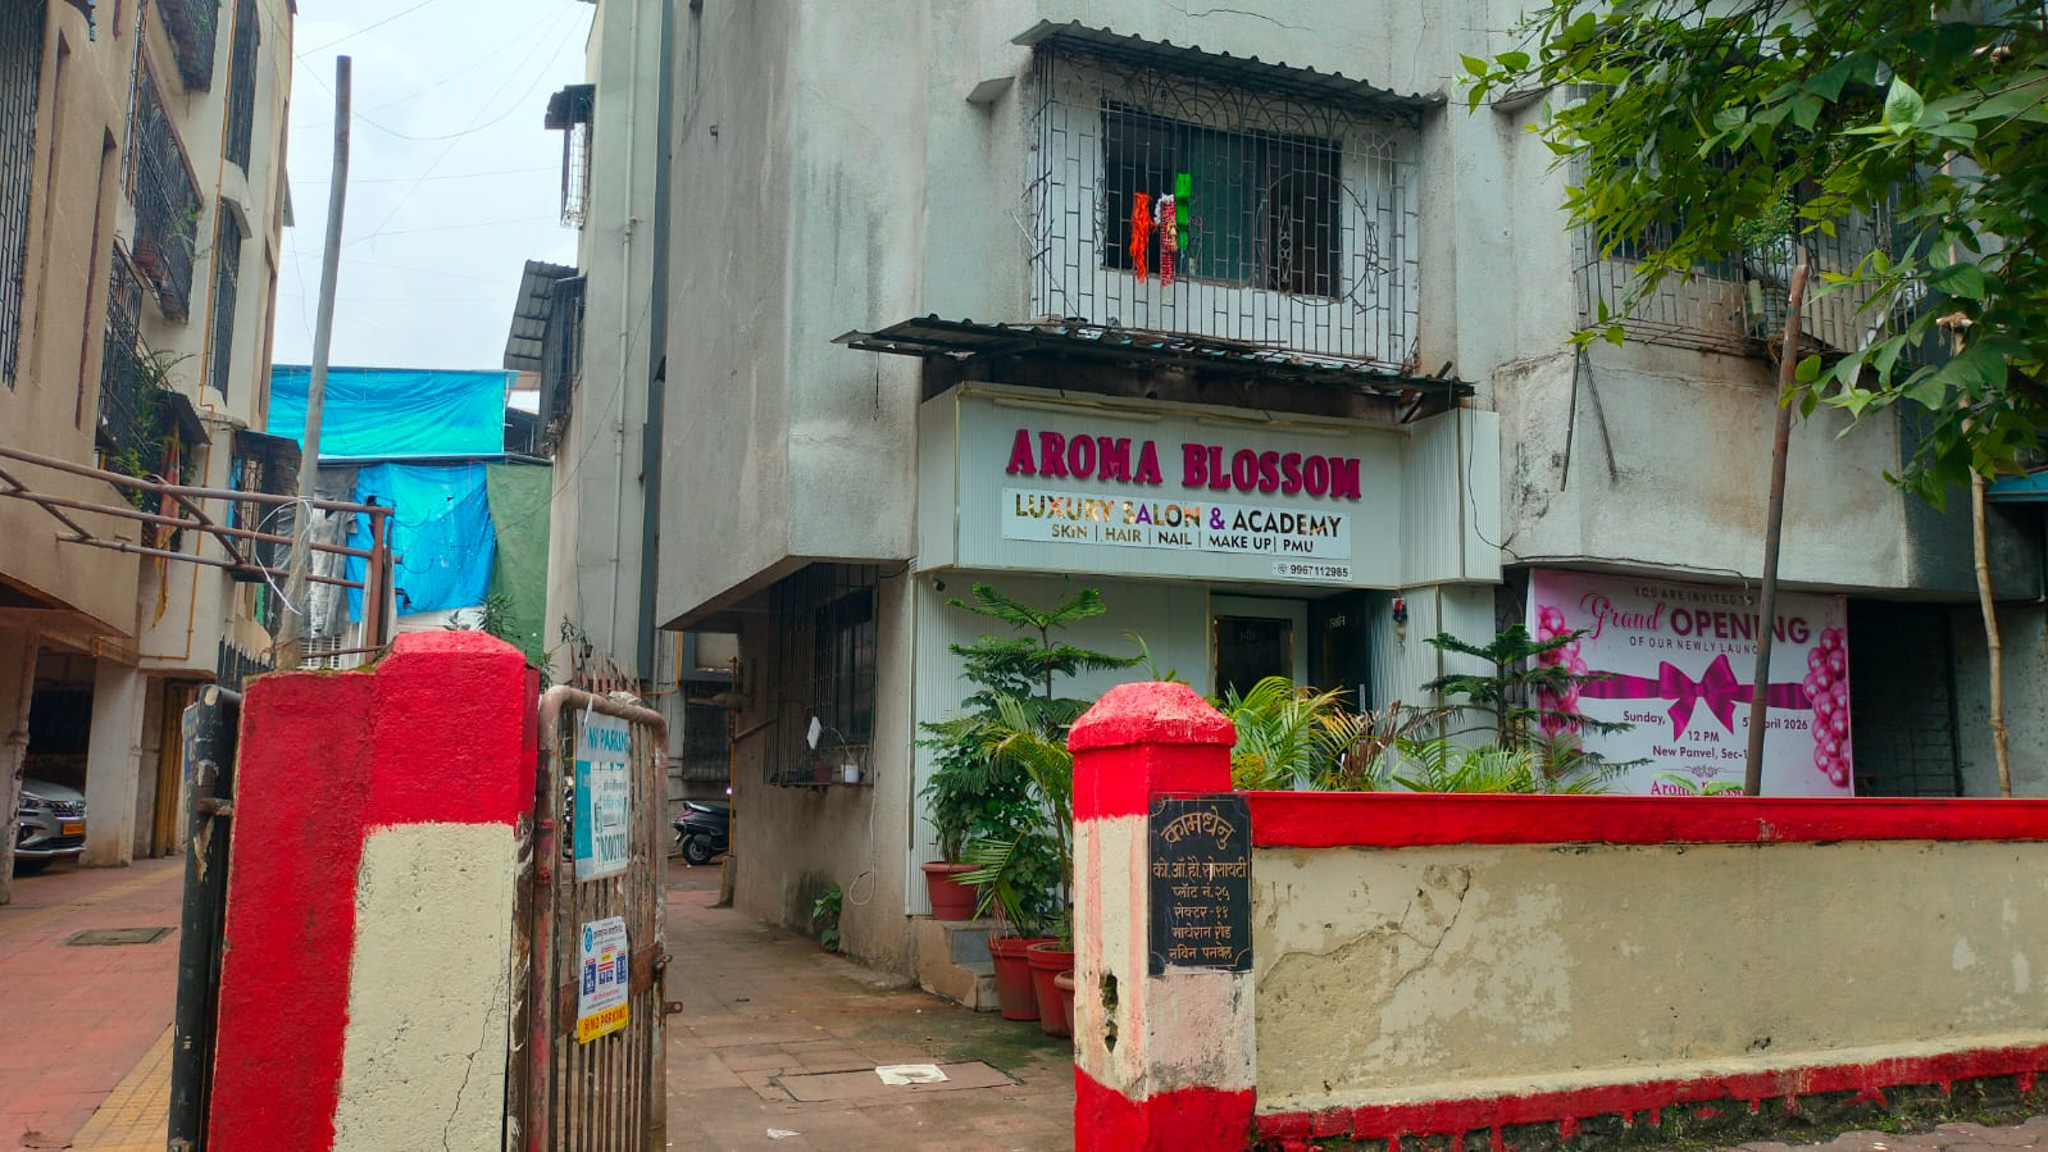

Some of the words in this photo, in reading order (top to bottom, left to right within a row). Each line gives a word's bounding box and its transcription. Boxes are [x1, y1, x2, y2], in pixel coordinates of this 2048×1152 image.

[1006, 429, 1163, 485] AROMA
[1181, 443, 1362, 500] BLOSSOM
[1015, 493, 1114, 523] LUXURY
[1123, 500, 1200, 528] SALON
[1209, 507, 1225, 530] &
[1232, 509, 1342, 538] ACADEMY
[1105, 527, 1142, 543] HAIR
[1158, 531, 1192, 546] NAIL
[1208, 534, 1248, 549] MAKE
[1283, 539, 1314, 553] PMU
[1290, 564, 1349, 578] 9967112985
[1634, 585, 1658, 599] YOU
[1661, 588, 1687, 601] ARE
[1688, 590, 1738, 605] INVITED
[1580, 591, 1665, 639] Grand
[1629, 636, 1645, 647] OF
[1648, 637, 1673, 648] OUR
[1677, 639, 1716, 653] NEWLY
[1720, 643, 1759, 655] LAUNC
[1623, 711, 1666, 725] Sunday,
[1783, 719, 1808, 730] 2026
[1687, 729, 1700, 742] 12
[1704, 731, 1720, 743] PM
[1652, 745, 1677, 756] New
[1680, 747, 1719, 761] Panvel,
[1721, 748, 1748, 760] Sec-1
[1651, 780, 1693, 796] Arom
[1160, 804, 1237, 850] कामधेनु
[1171, 883, 1199, 898] प्लॉट
[1214, 922, 1233, 939] रोड
[1168, 943, 1197, 960] नविन
[1201, 942, 1233, 960] पनवेल
